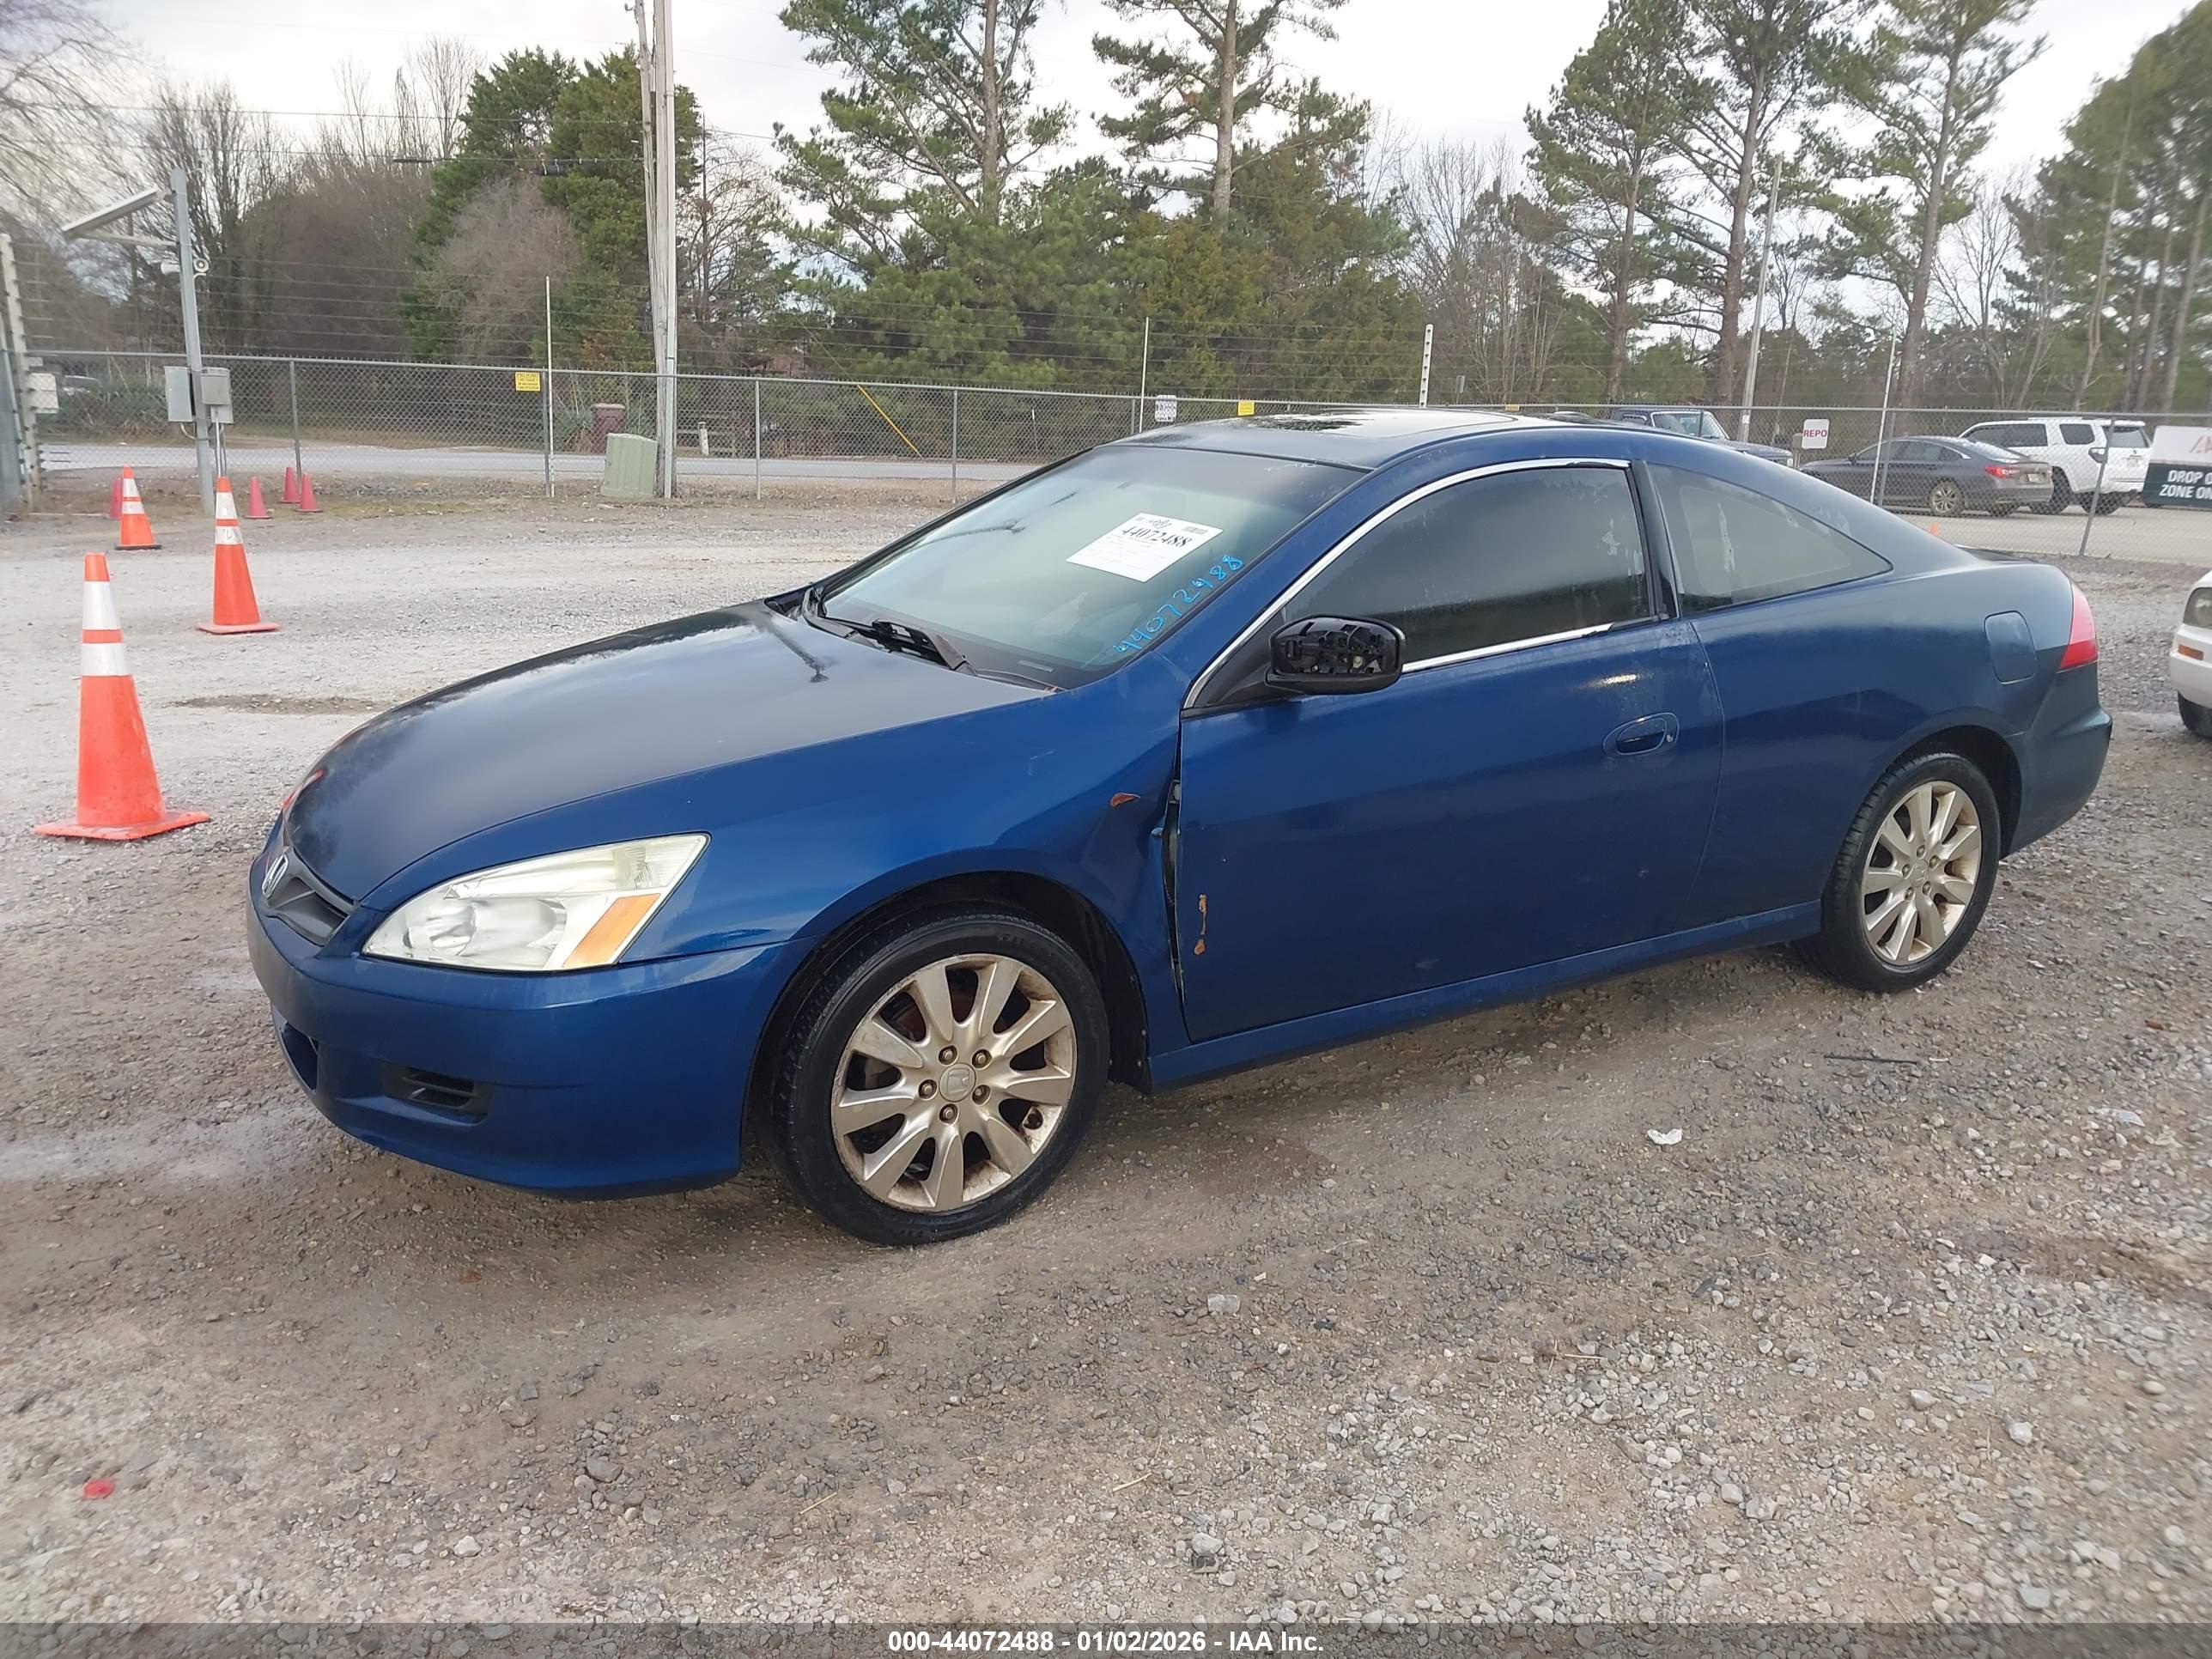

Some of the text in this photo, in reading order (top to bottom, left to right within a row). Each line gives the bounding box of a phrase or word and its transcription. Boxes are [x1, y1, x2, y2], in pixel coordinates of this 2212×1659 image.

[2167, 470, 2203, 483] DROP
[2159, 484, 2195, 498] ZONE
[1122, 526, 1193, 547] 44072488
[1113, 555, 1243, 653] 44072488
